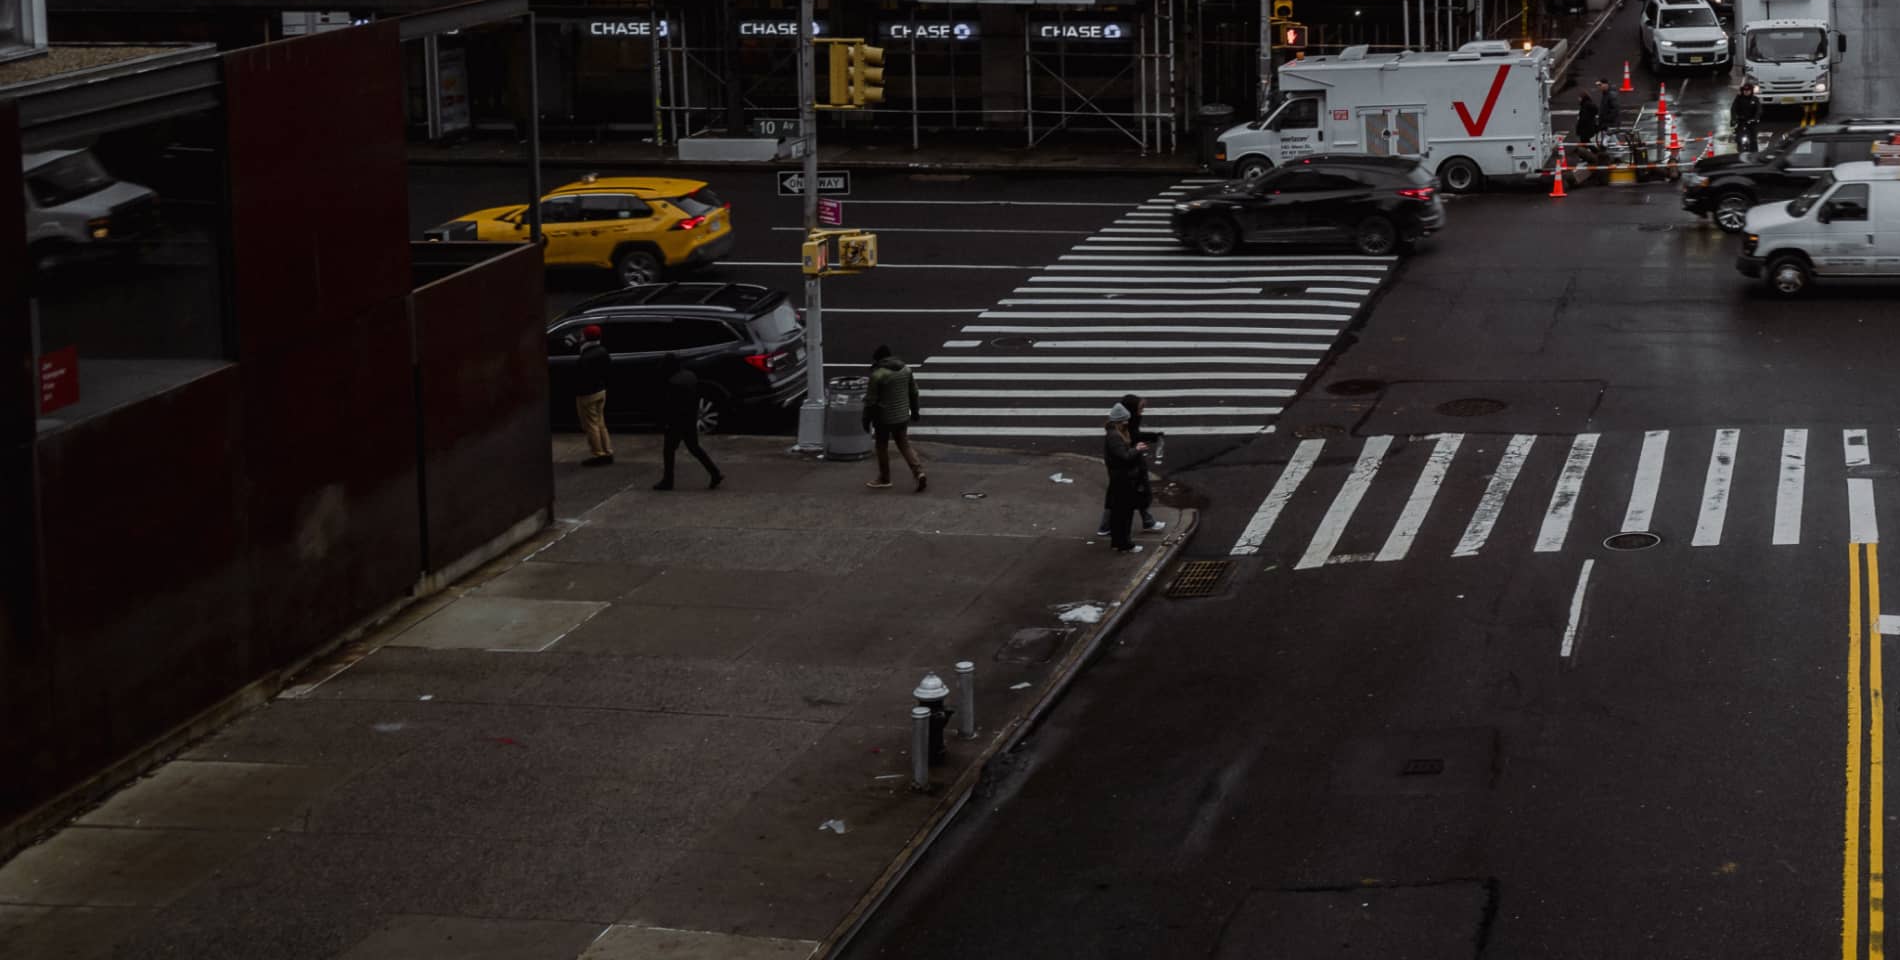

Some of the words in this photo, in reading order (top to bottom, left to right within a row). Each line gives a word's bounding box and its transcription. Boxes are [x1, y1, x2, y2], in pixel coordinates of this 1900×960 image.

[590, 21, 652, 36] CHASE
[740, 22, 798, 35] CHASE
[1040, 25, 1102, 38] CHASE
[759, 120, 776, 135] 10
